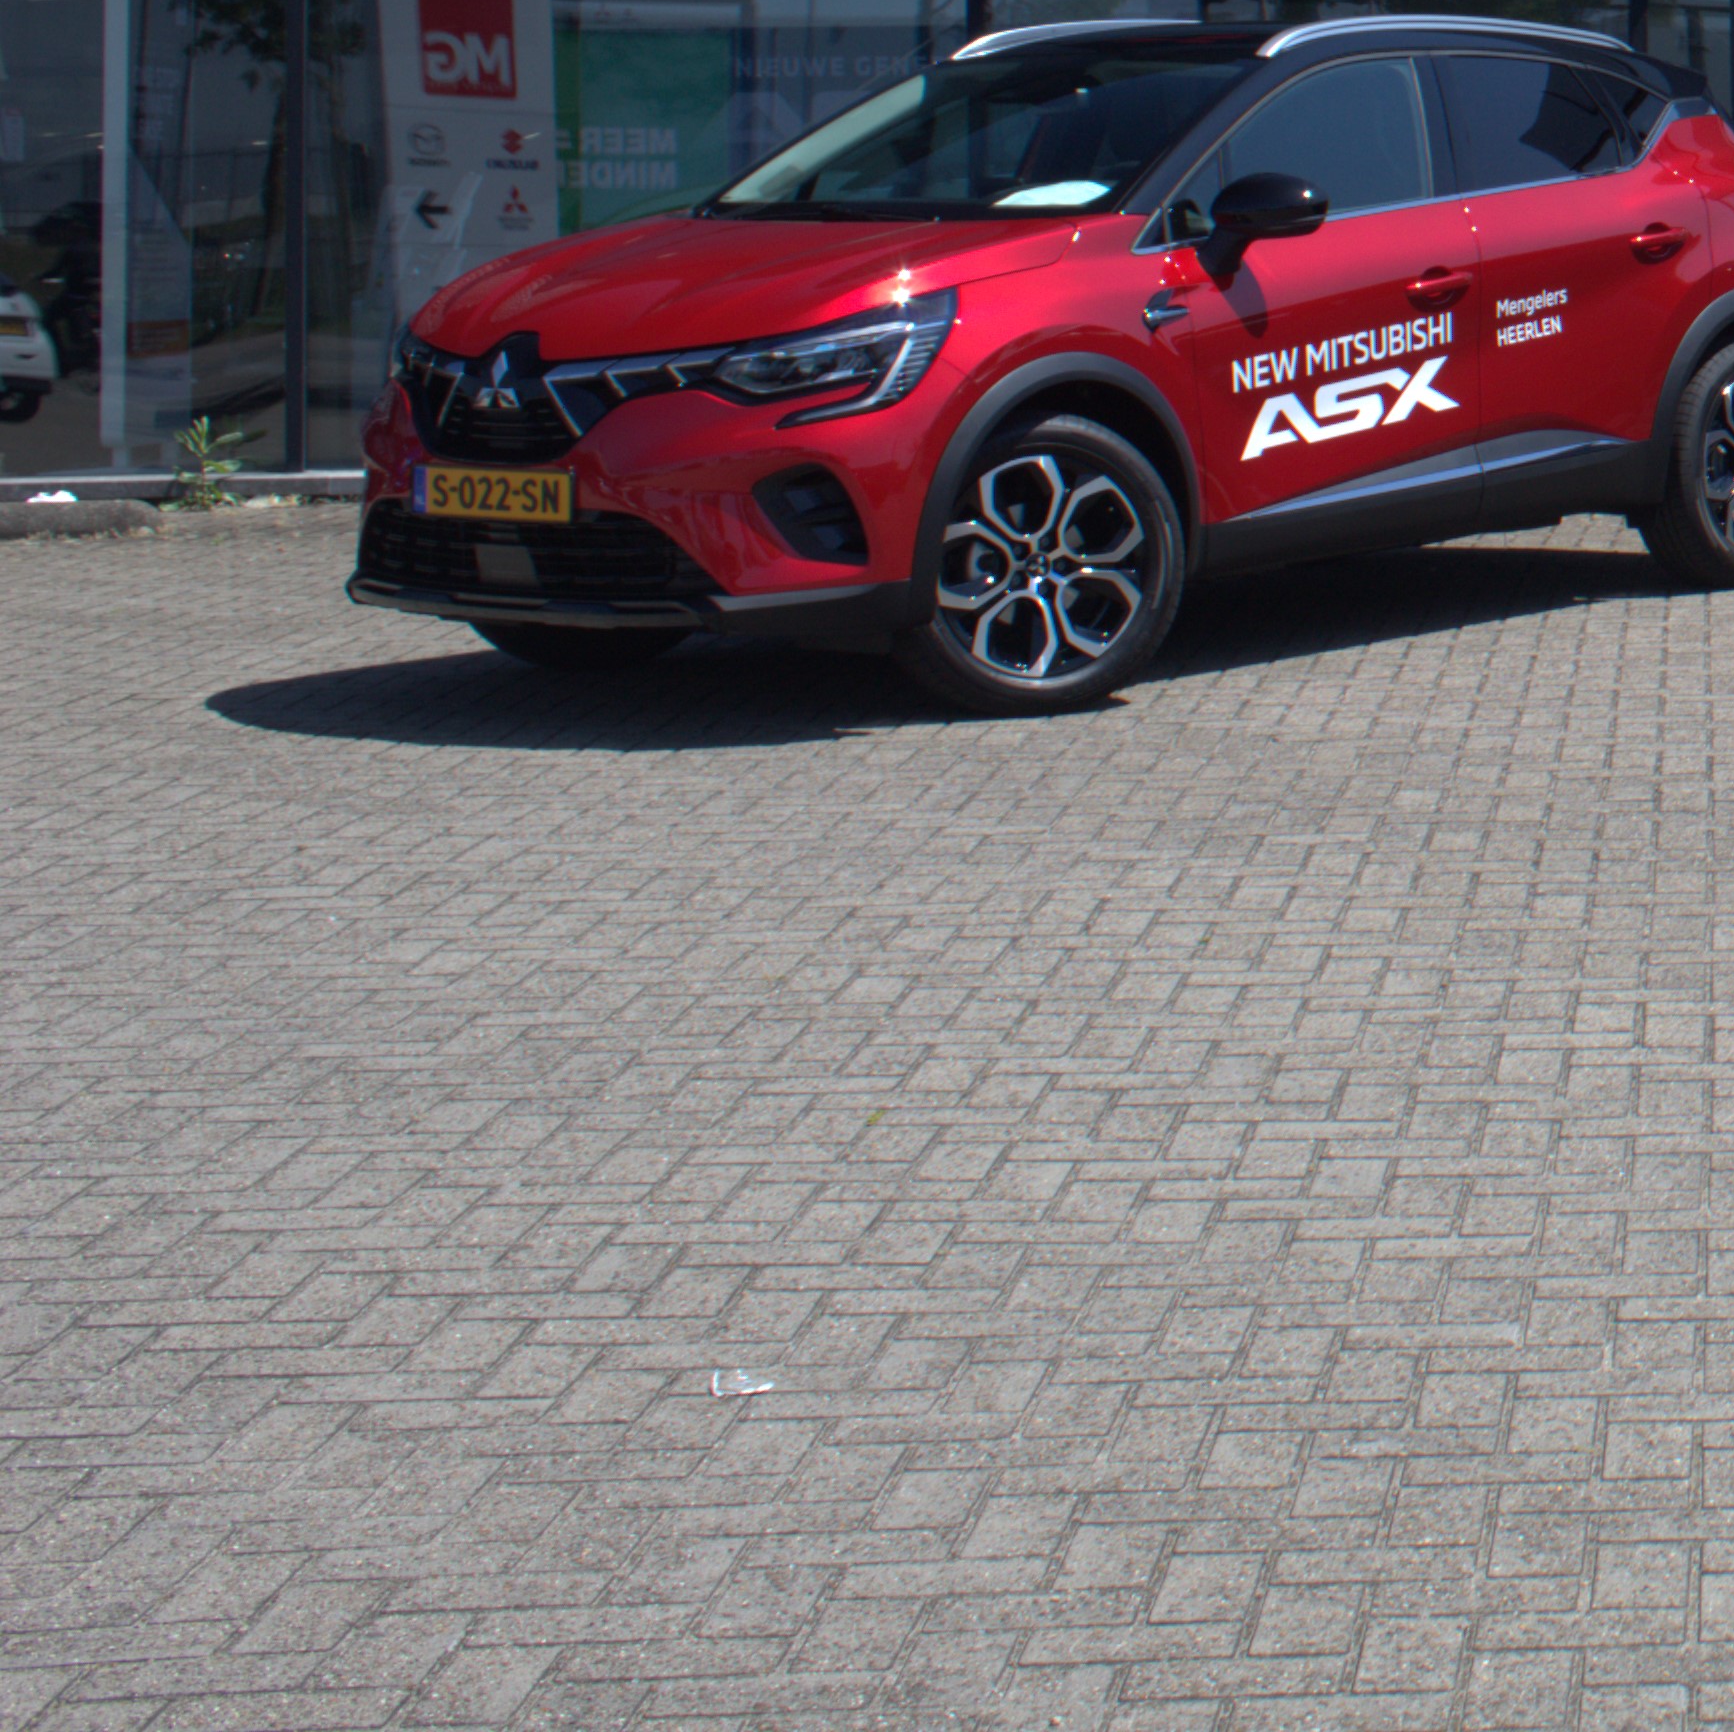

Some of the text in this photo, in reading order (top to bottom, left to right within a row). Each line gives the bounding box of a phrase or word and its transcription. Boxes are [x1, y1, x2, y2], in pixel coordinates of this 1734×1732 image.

[1495, 287, 1569, 319] Mengelers
[1496, 314, 1563, 347] HEERLEN
[1231, 311, 1454, 394] NEW MITSUBISHI
[1240, 354, 1461, 462] ASX
[432, 473, 560, 514] S-022-SN
